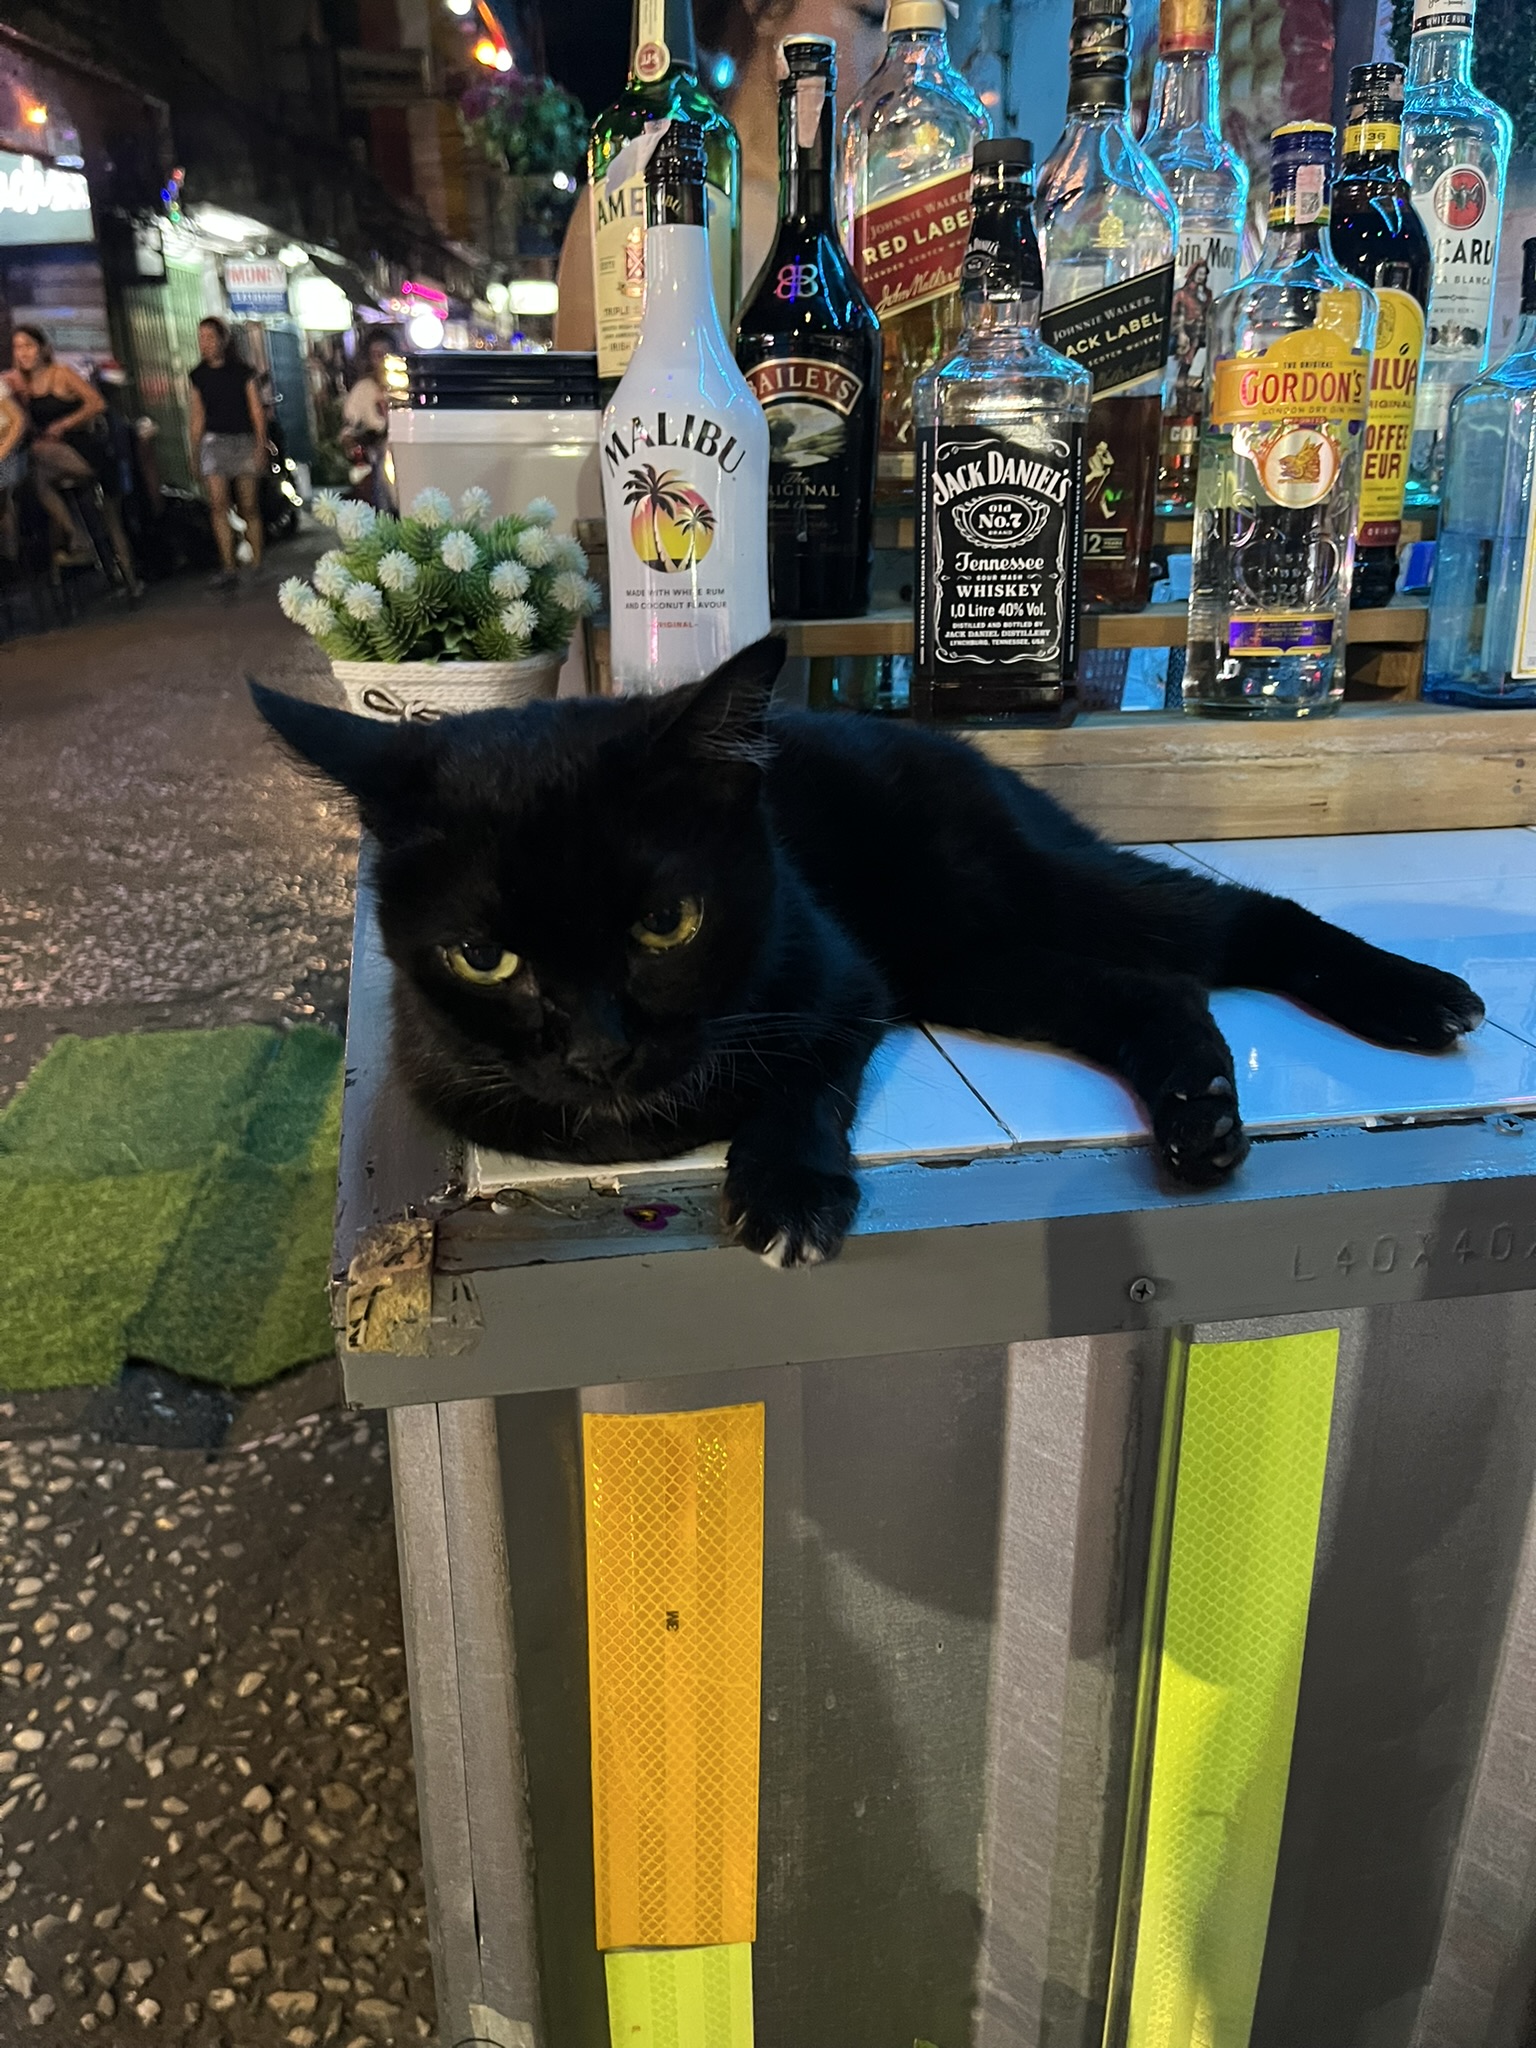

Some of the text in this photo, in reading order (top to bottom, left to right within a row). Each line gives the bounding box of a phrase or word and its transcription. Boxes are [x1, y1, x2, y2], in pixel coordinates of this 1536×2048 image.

[1426, 15, 1450, 26] WHITE
[869, 208, 922, 241] JOHNNIE
[862, 209, 970, 266] RED LABE
[1053, 315, 1103, 345] JOHNNIE
[1065, 311, 1164, 358] ACK LABEL
[747, 366, 856, 400] BAILEYS
[1239, 368, 1362, 408] GORDON'S
[604, 412, 746, 479] MALIBU
[931, 450, 1073, 506] JACK DANIEL'S
[988, 503, 1012, 513] Old
[977, 512, 1023, 528] No.7
[1083, 533, 1101, 554] 12
[954, 552, 1045, 572] Tennessee
[673, 588, 703, 596] WHIE
[956, 583, 1043, 598] WHISKEY
[625, 602, 640, 610] AND
[968, 603, 996, 618] Litre
[997, 602, 1024, 617] 40%
[1026, 601, 1047, 616] Vol.
[967, 630, 1000, 638] DANIEL
[1001, 629, 1051, 637] DISTILLERY
[665, 1610, 680, 1632] 3M
